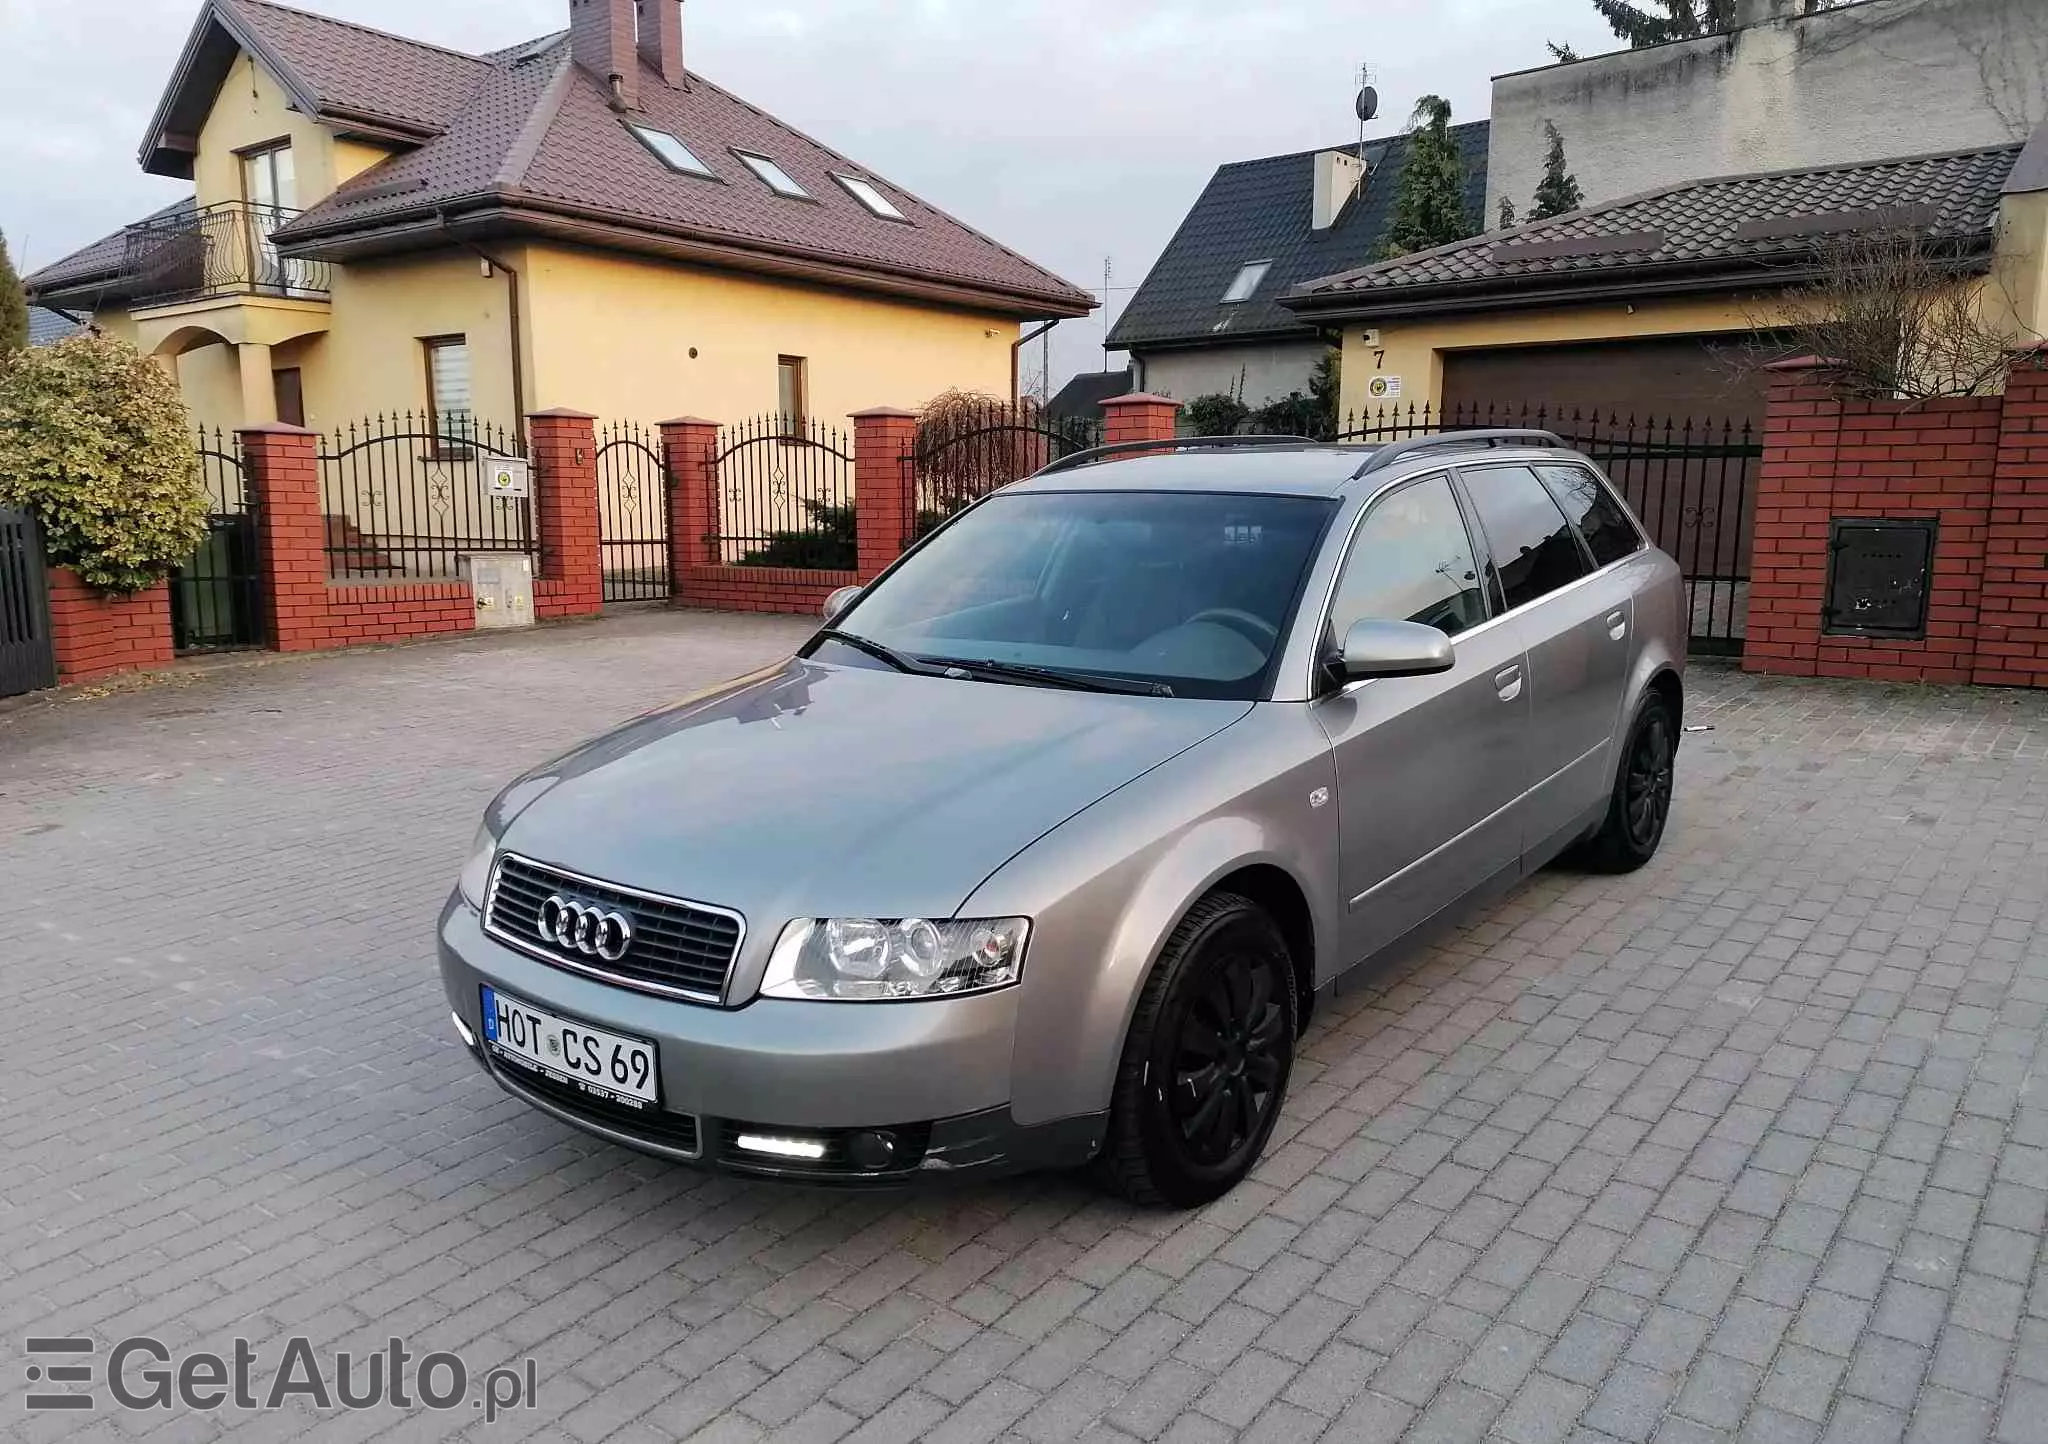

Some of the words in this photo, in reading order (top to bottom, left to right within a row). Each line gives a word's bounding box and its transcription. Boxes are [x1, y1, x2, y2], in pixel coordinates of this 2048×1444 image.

[1374, 350, 1384, 369] 7
[496, 1000, 541, 1055] HOT
[562, 1028, 601, 1075] CS
[611, 1044, 649, 1089] 69
